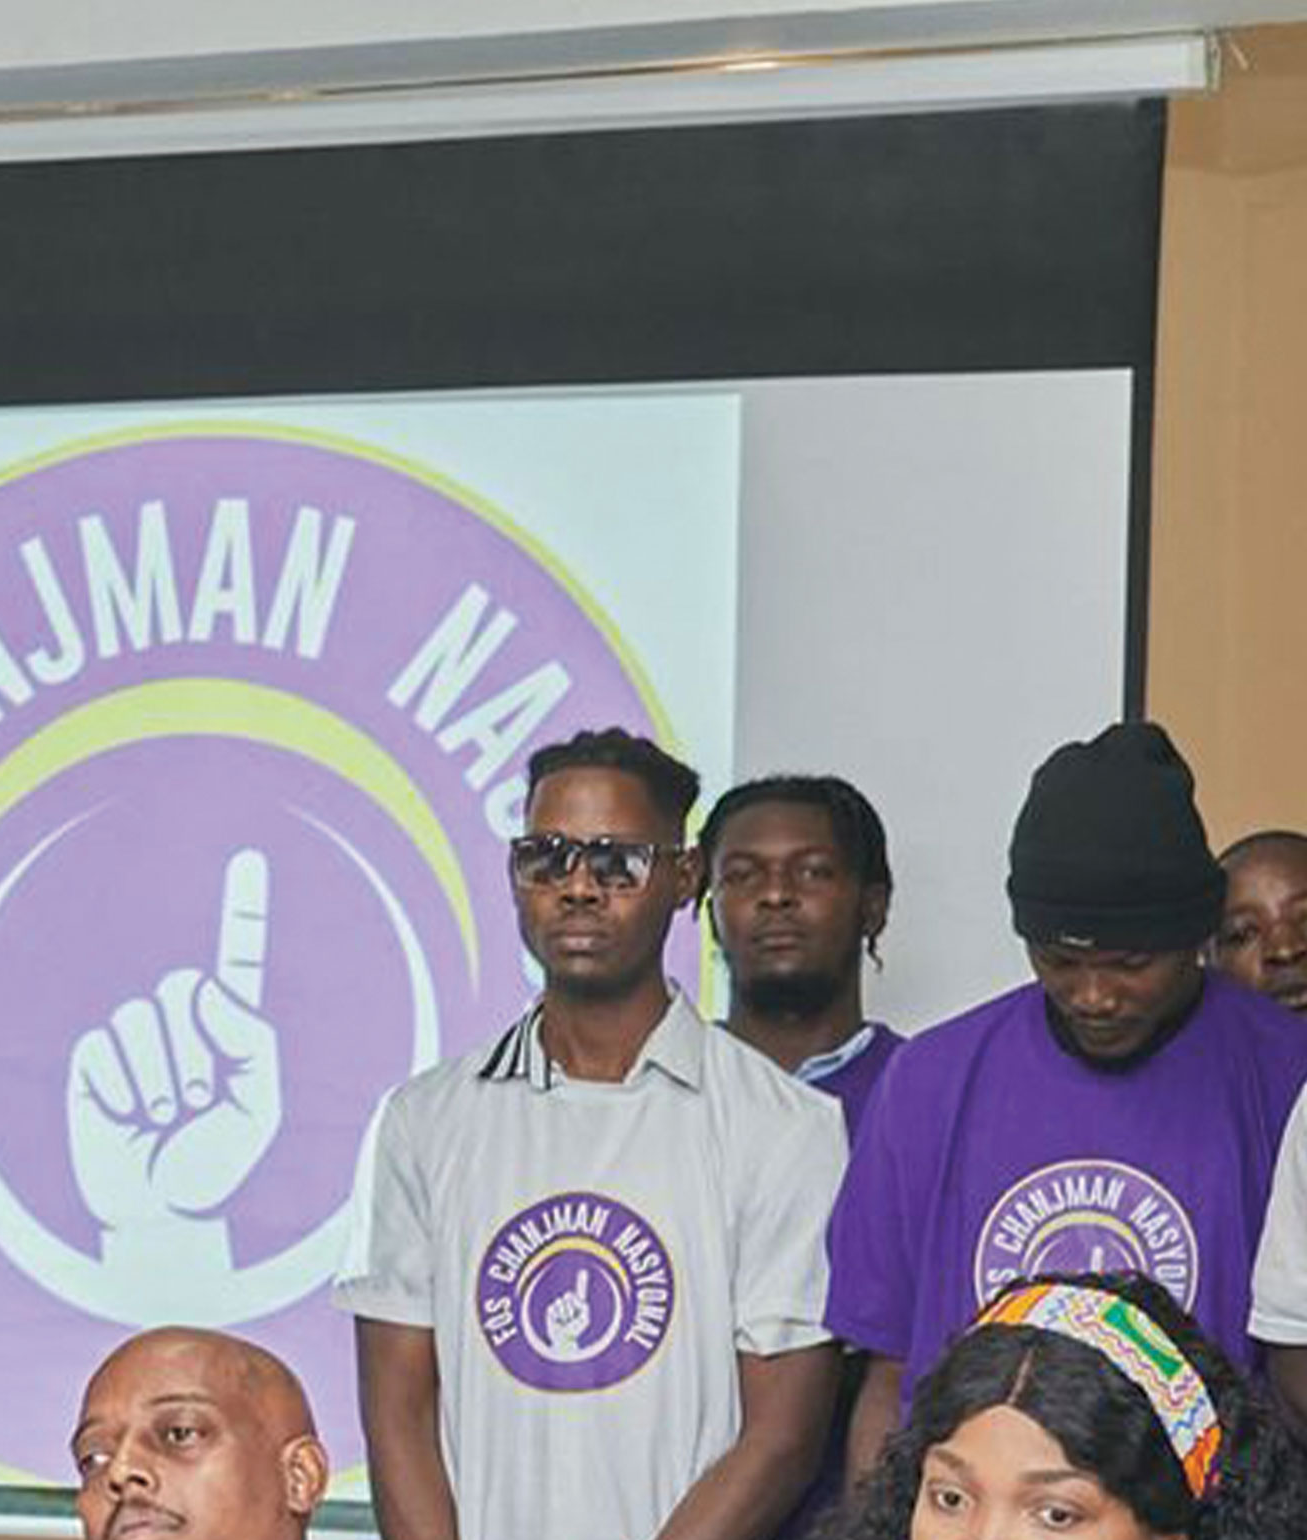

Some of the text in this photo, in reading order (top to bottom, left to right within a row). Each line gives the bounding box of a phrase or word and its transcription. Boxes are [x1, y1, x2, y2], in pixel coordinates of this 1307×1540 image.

[995, 1174, 1125, 1254] CHANJMAN
[489, 1202, 611, 1283] CHANJMAN
[612, 1223, 669, 1350] NASYONAL
